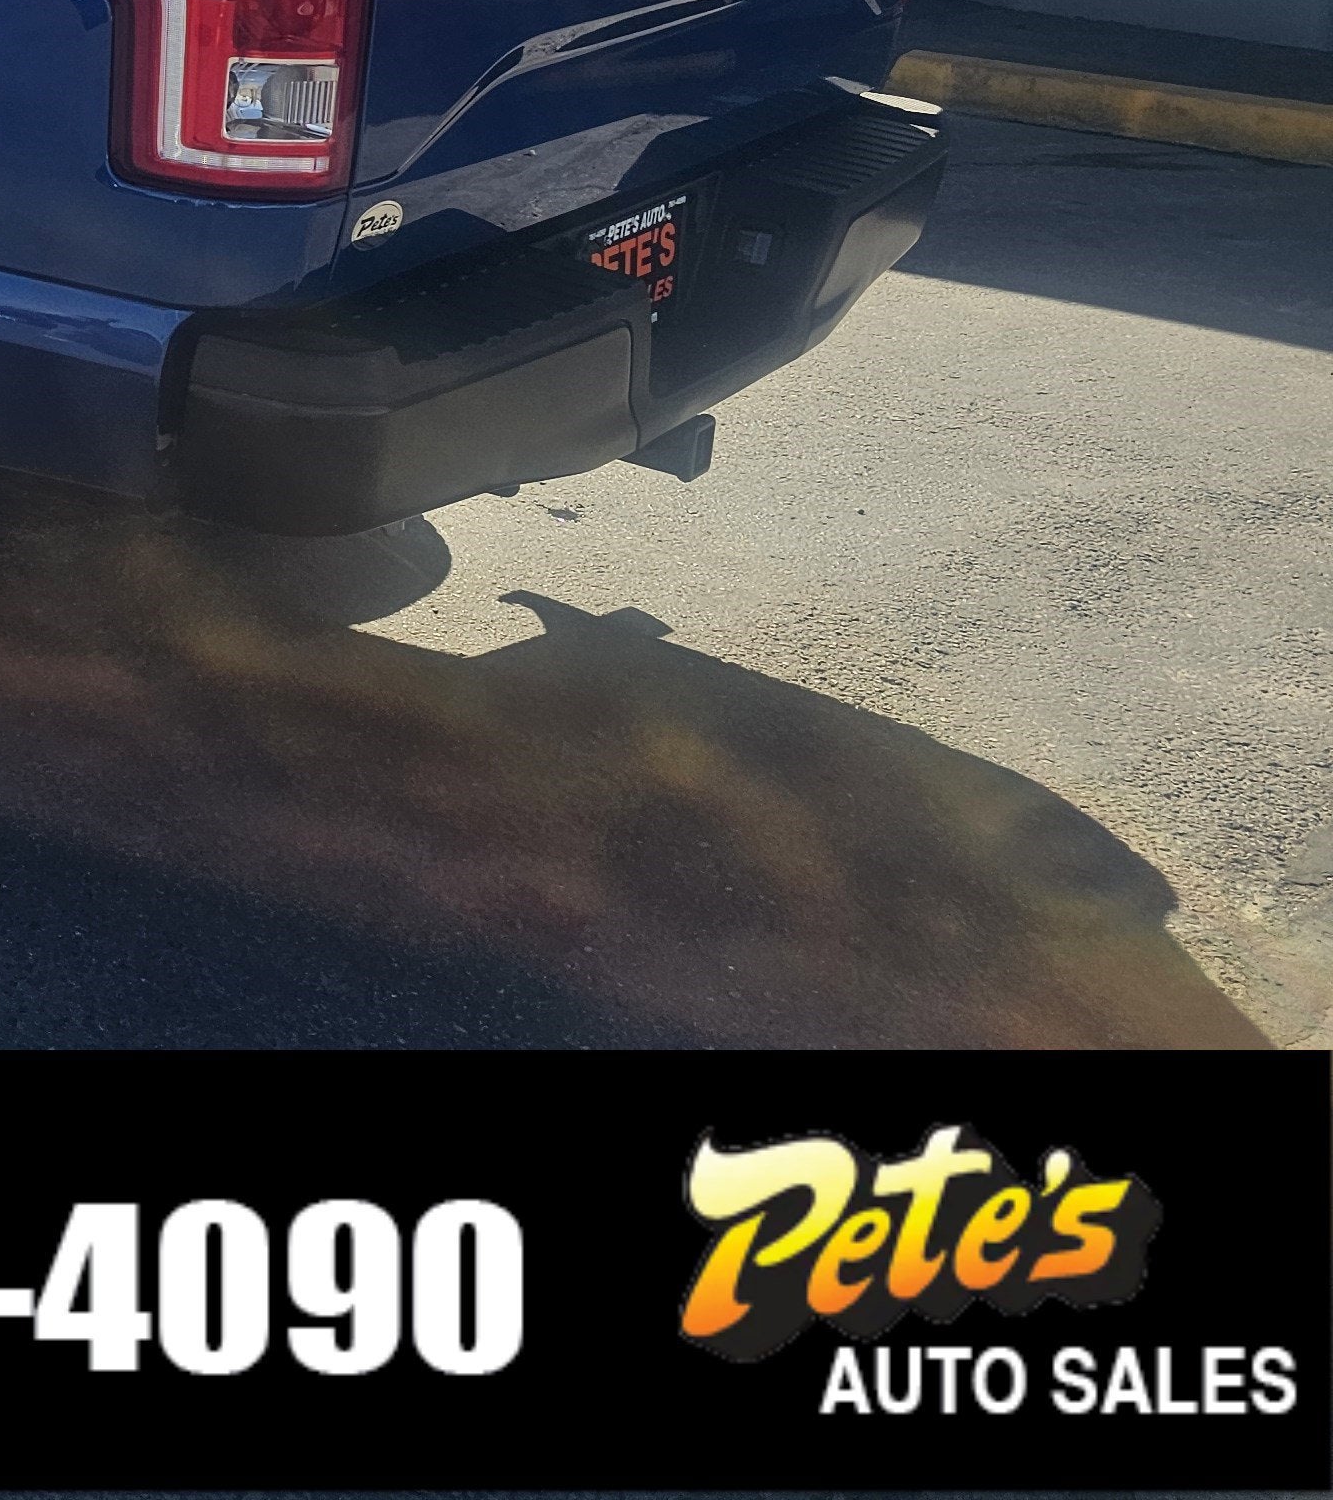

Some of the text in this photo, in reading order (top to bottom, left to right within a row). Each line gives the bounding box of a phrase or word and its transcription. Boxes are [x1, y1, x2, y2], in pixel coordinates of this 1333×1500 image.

[356, 213, 399, 238] Pete's
[608, 214, 640, 241] PETE'S
[640, 204, 665, 230] AUTO
